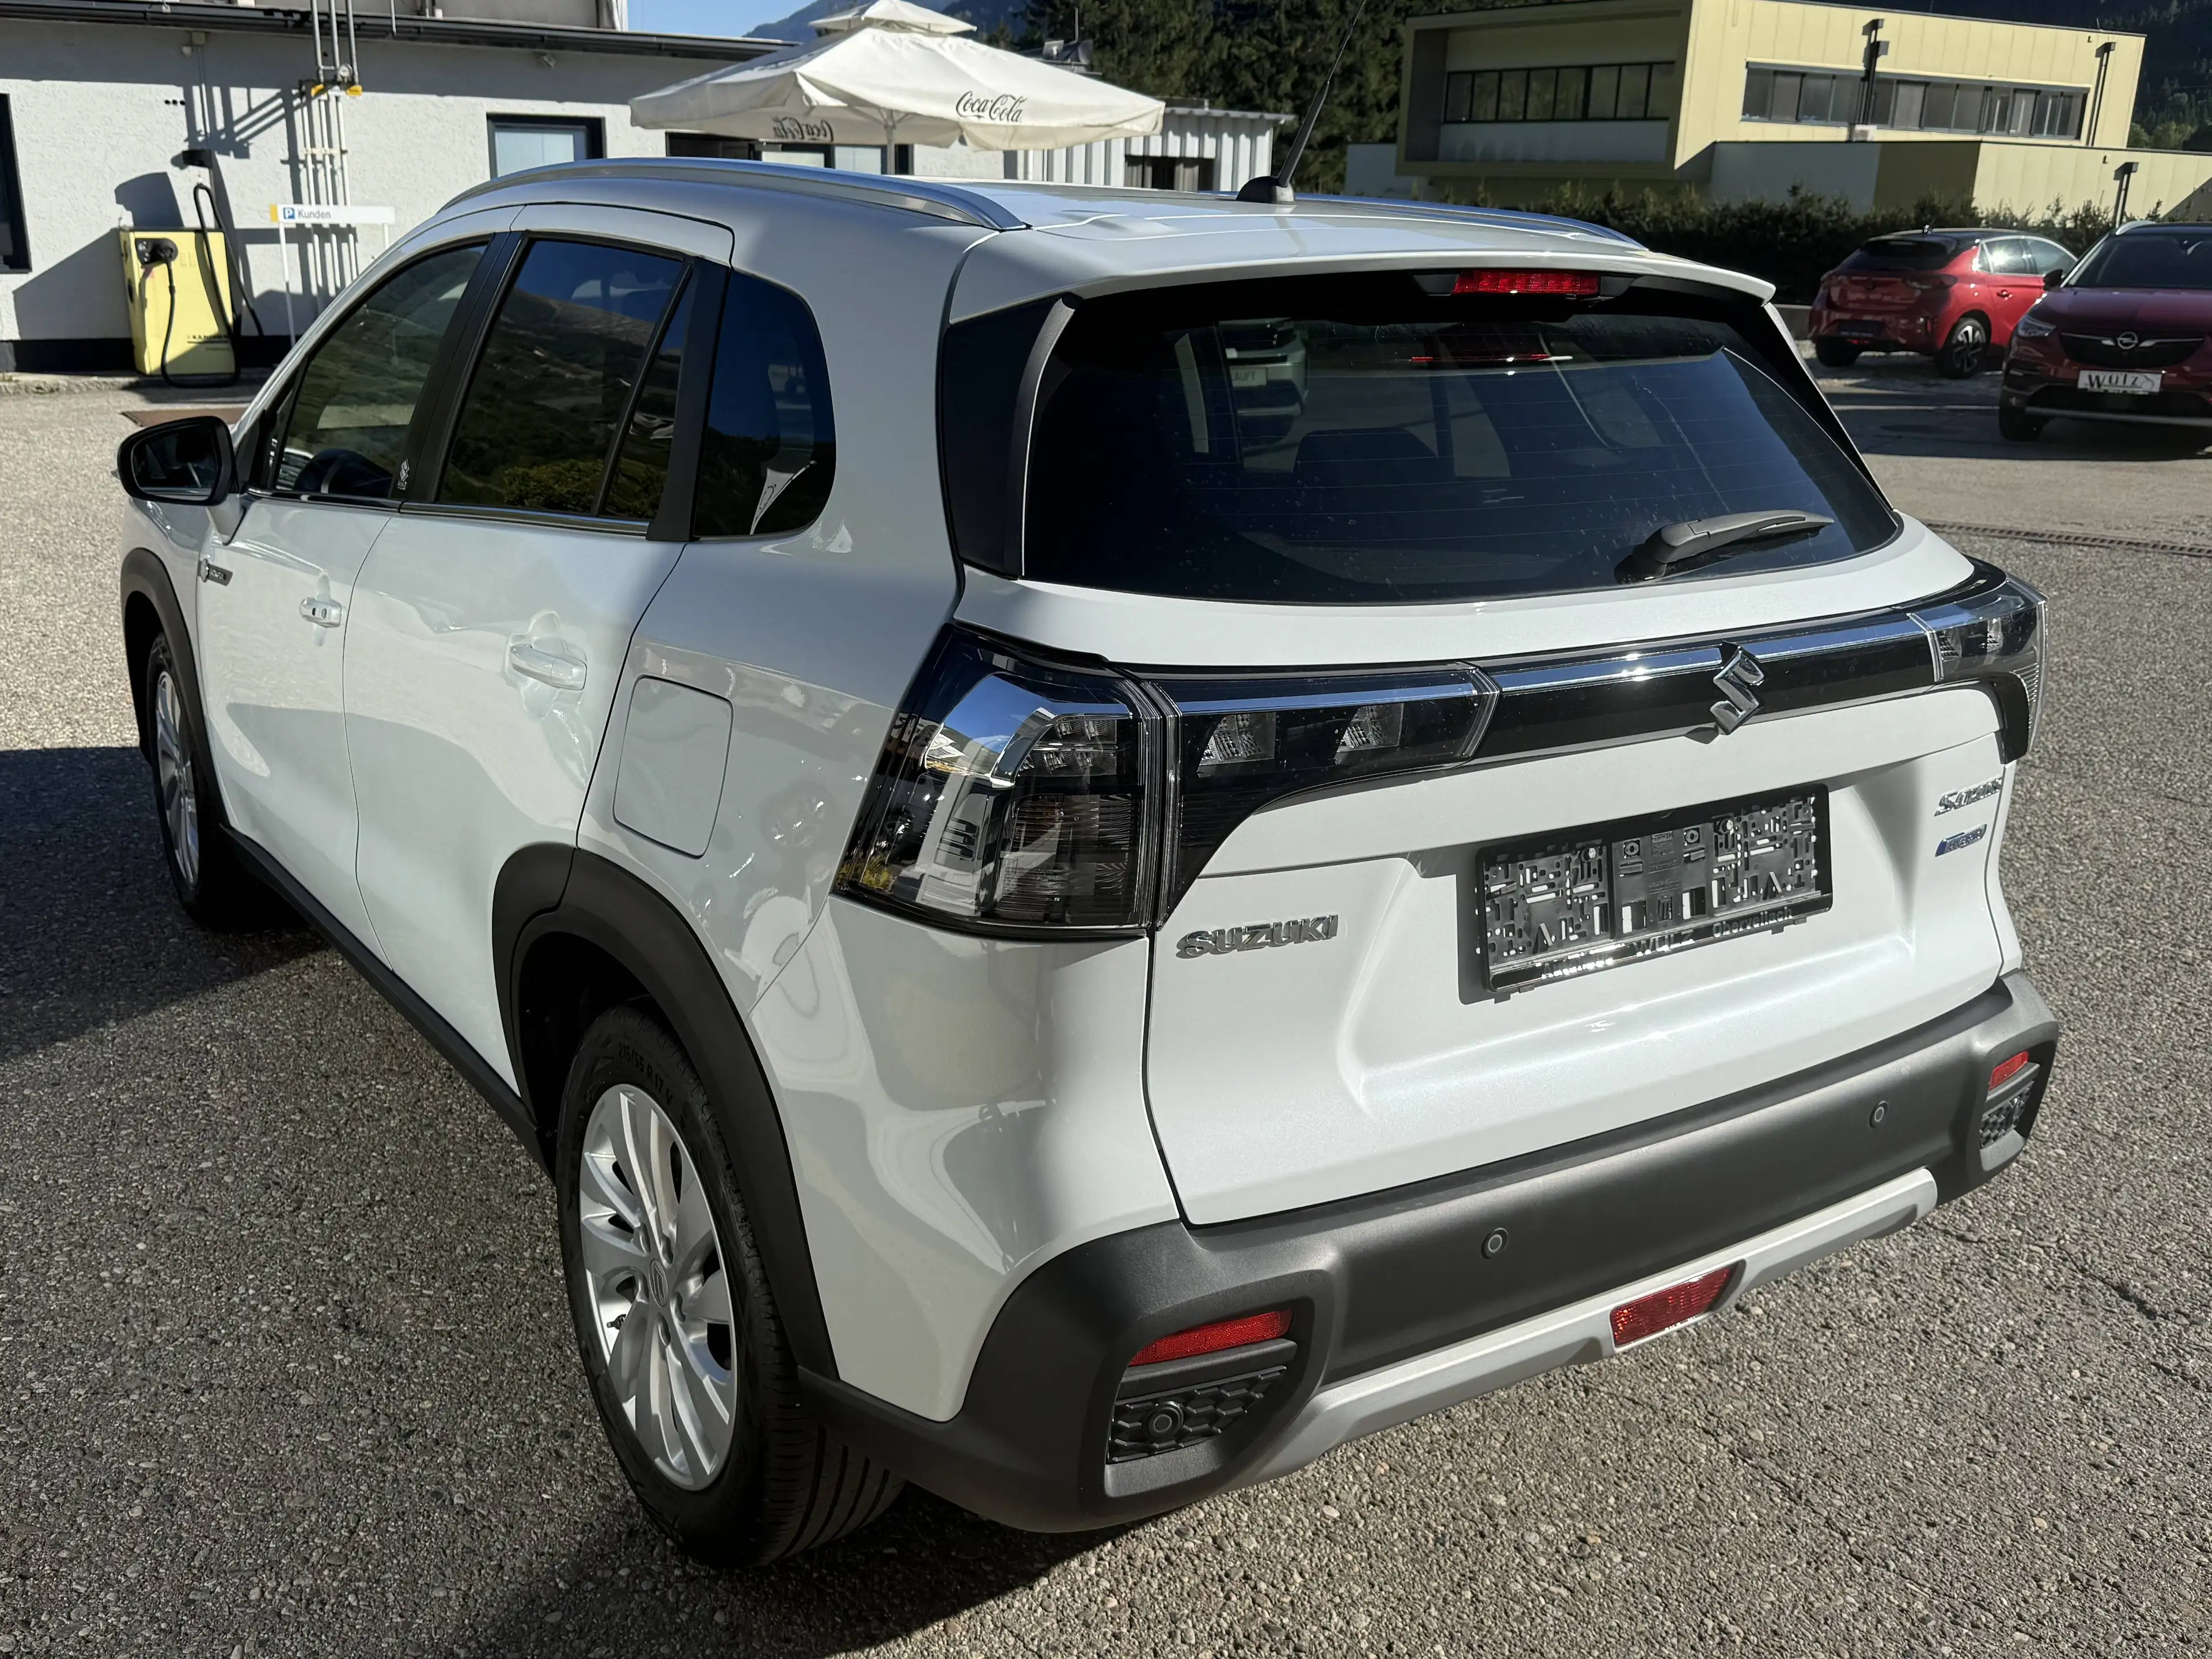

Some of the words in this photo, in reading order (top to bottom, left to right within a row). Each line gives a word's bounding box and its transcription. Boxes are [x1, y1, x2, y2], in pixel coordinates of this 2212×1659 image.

[298, 209, 331, 218] Kunden
[1184, 915, 1338, 956] SUZUKI
[1712, 906, 1793, 937] Obervellach
